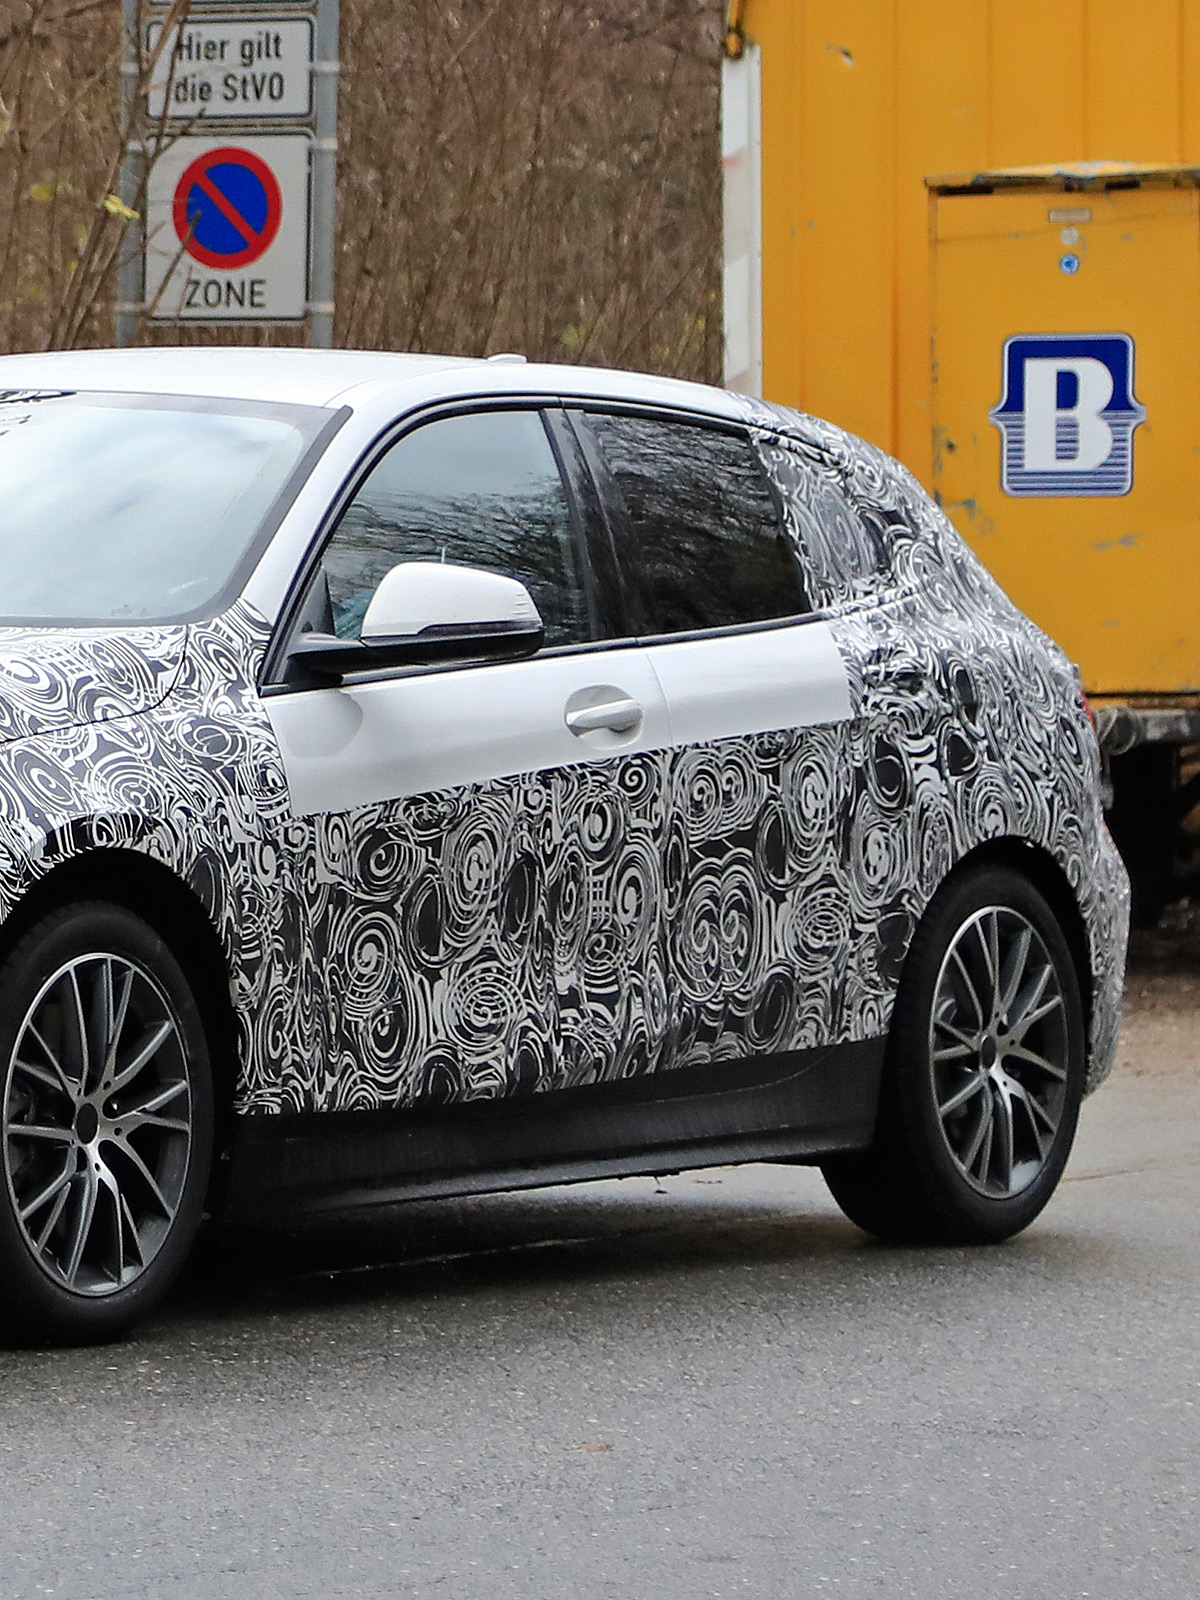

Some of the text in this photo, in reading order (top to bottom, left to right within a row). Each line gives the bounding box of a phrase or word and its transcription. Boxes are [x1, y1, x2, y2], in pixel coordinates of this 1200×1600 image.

[176, 31, 282, 67] Hier gilt
[174, 73, 284, 102] die StVO
[185, 279, 267, 308] ZONE
[1024, 357, 1114, 471] B
